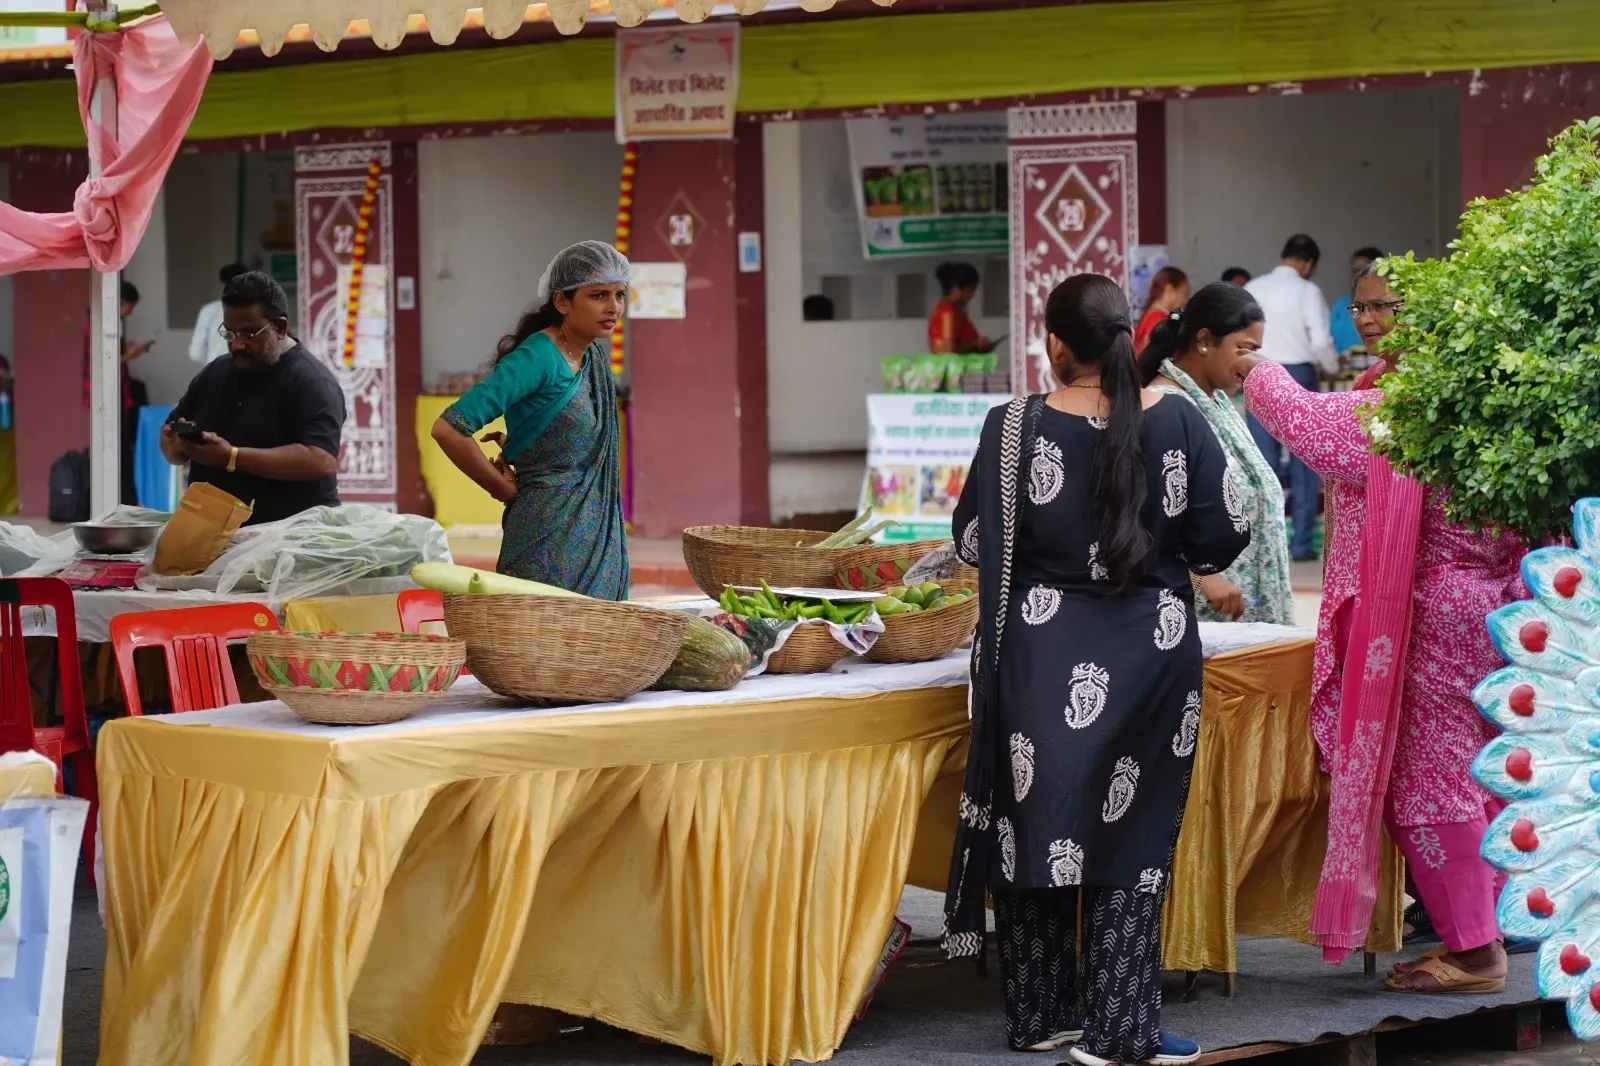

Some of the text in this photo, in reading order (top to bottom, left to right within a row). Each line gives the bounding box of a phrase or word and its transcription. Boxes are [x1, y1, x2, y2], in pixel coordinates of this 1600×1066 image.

[667, 73, 687, 94] एवं
[690, 73, 725, 92] मिलेट
[882, 948, 894, 965] Net
